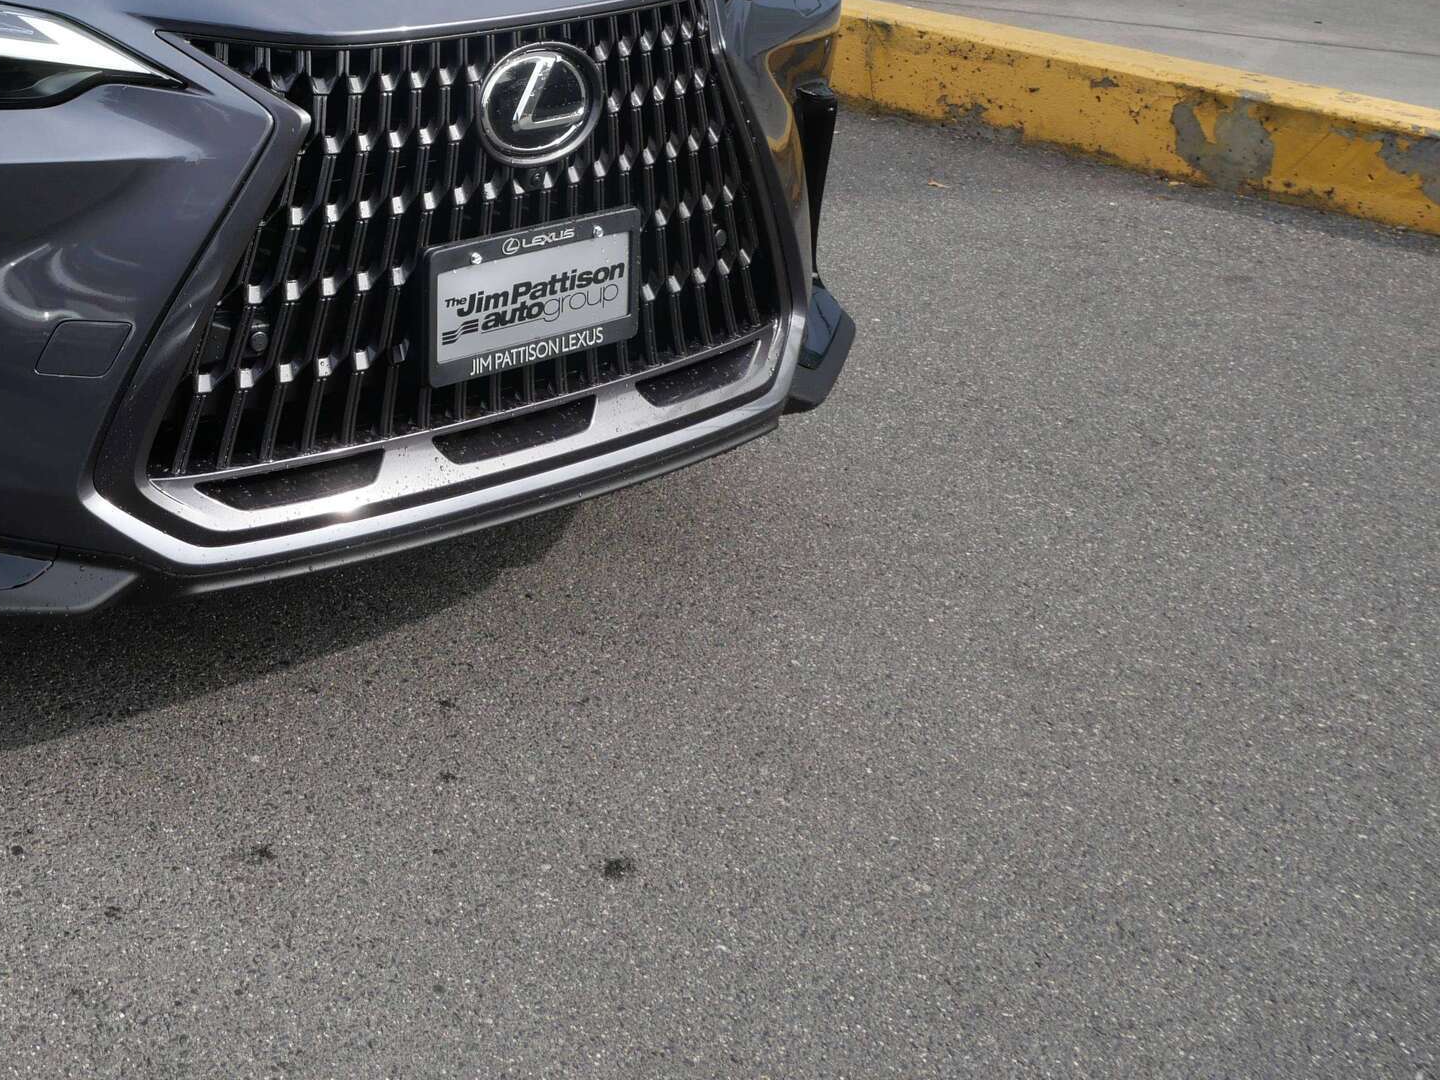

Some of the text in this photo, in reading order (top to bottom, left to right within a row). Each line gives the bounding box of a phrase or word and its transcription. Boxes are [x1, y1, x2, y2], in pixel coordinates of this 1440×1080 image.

[522, 228, 575, 250] LEXUS
[444, 295, 467, 309] The
[470, 327, 604, 376] JIM PATTISON LEXUS
